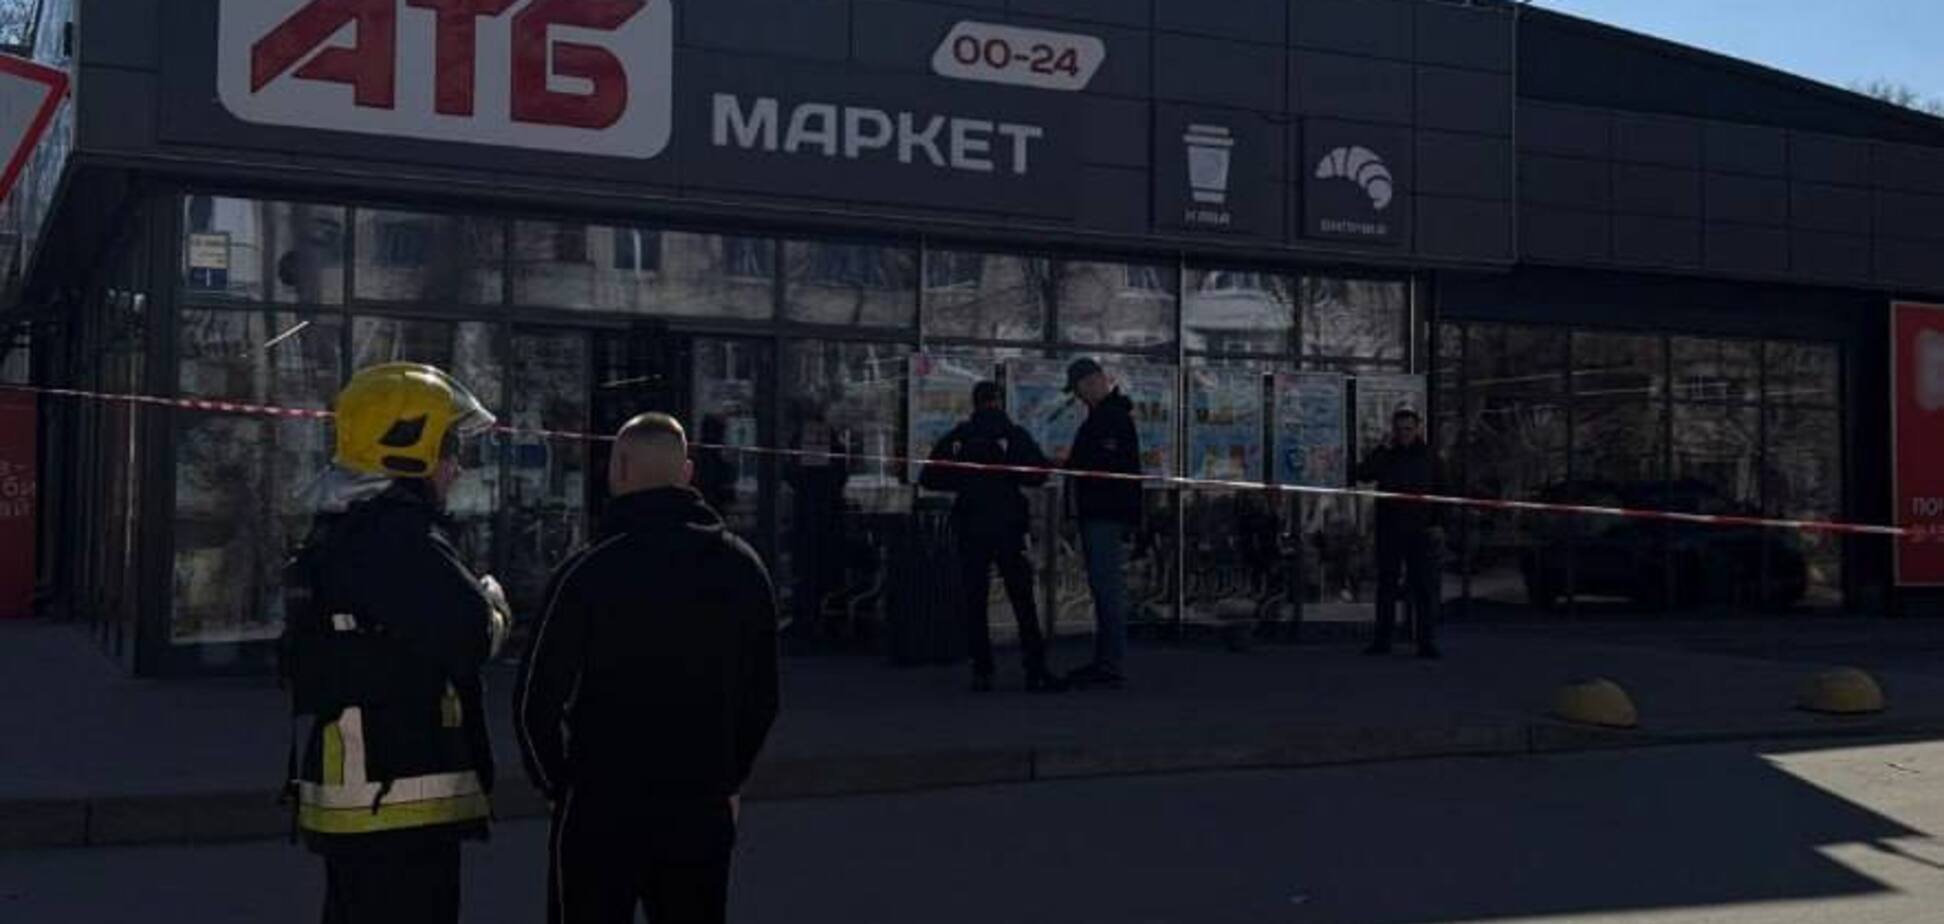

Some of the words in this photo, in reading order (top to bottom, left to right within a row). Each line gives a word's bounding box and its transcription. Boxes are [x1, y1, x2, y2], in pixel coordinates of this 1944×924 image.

[251, 0, 646, 129] АТБ
[953, 34, 1079, 76] 00-24
[712, 92, 1044, 175] МАРКЕТ
